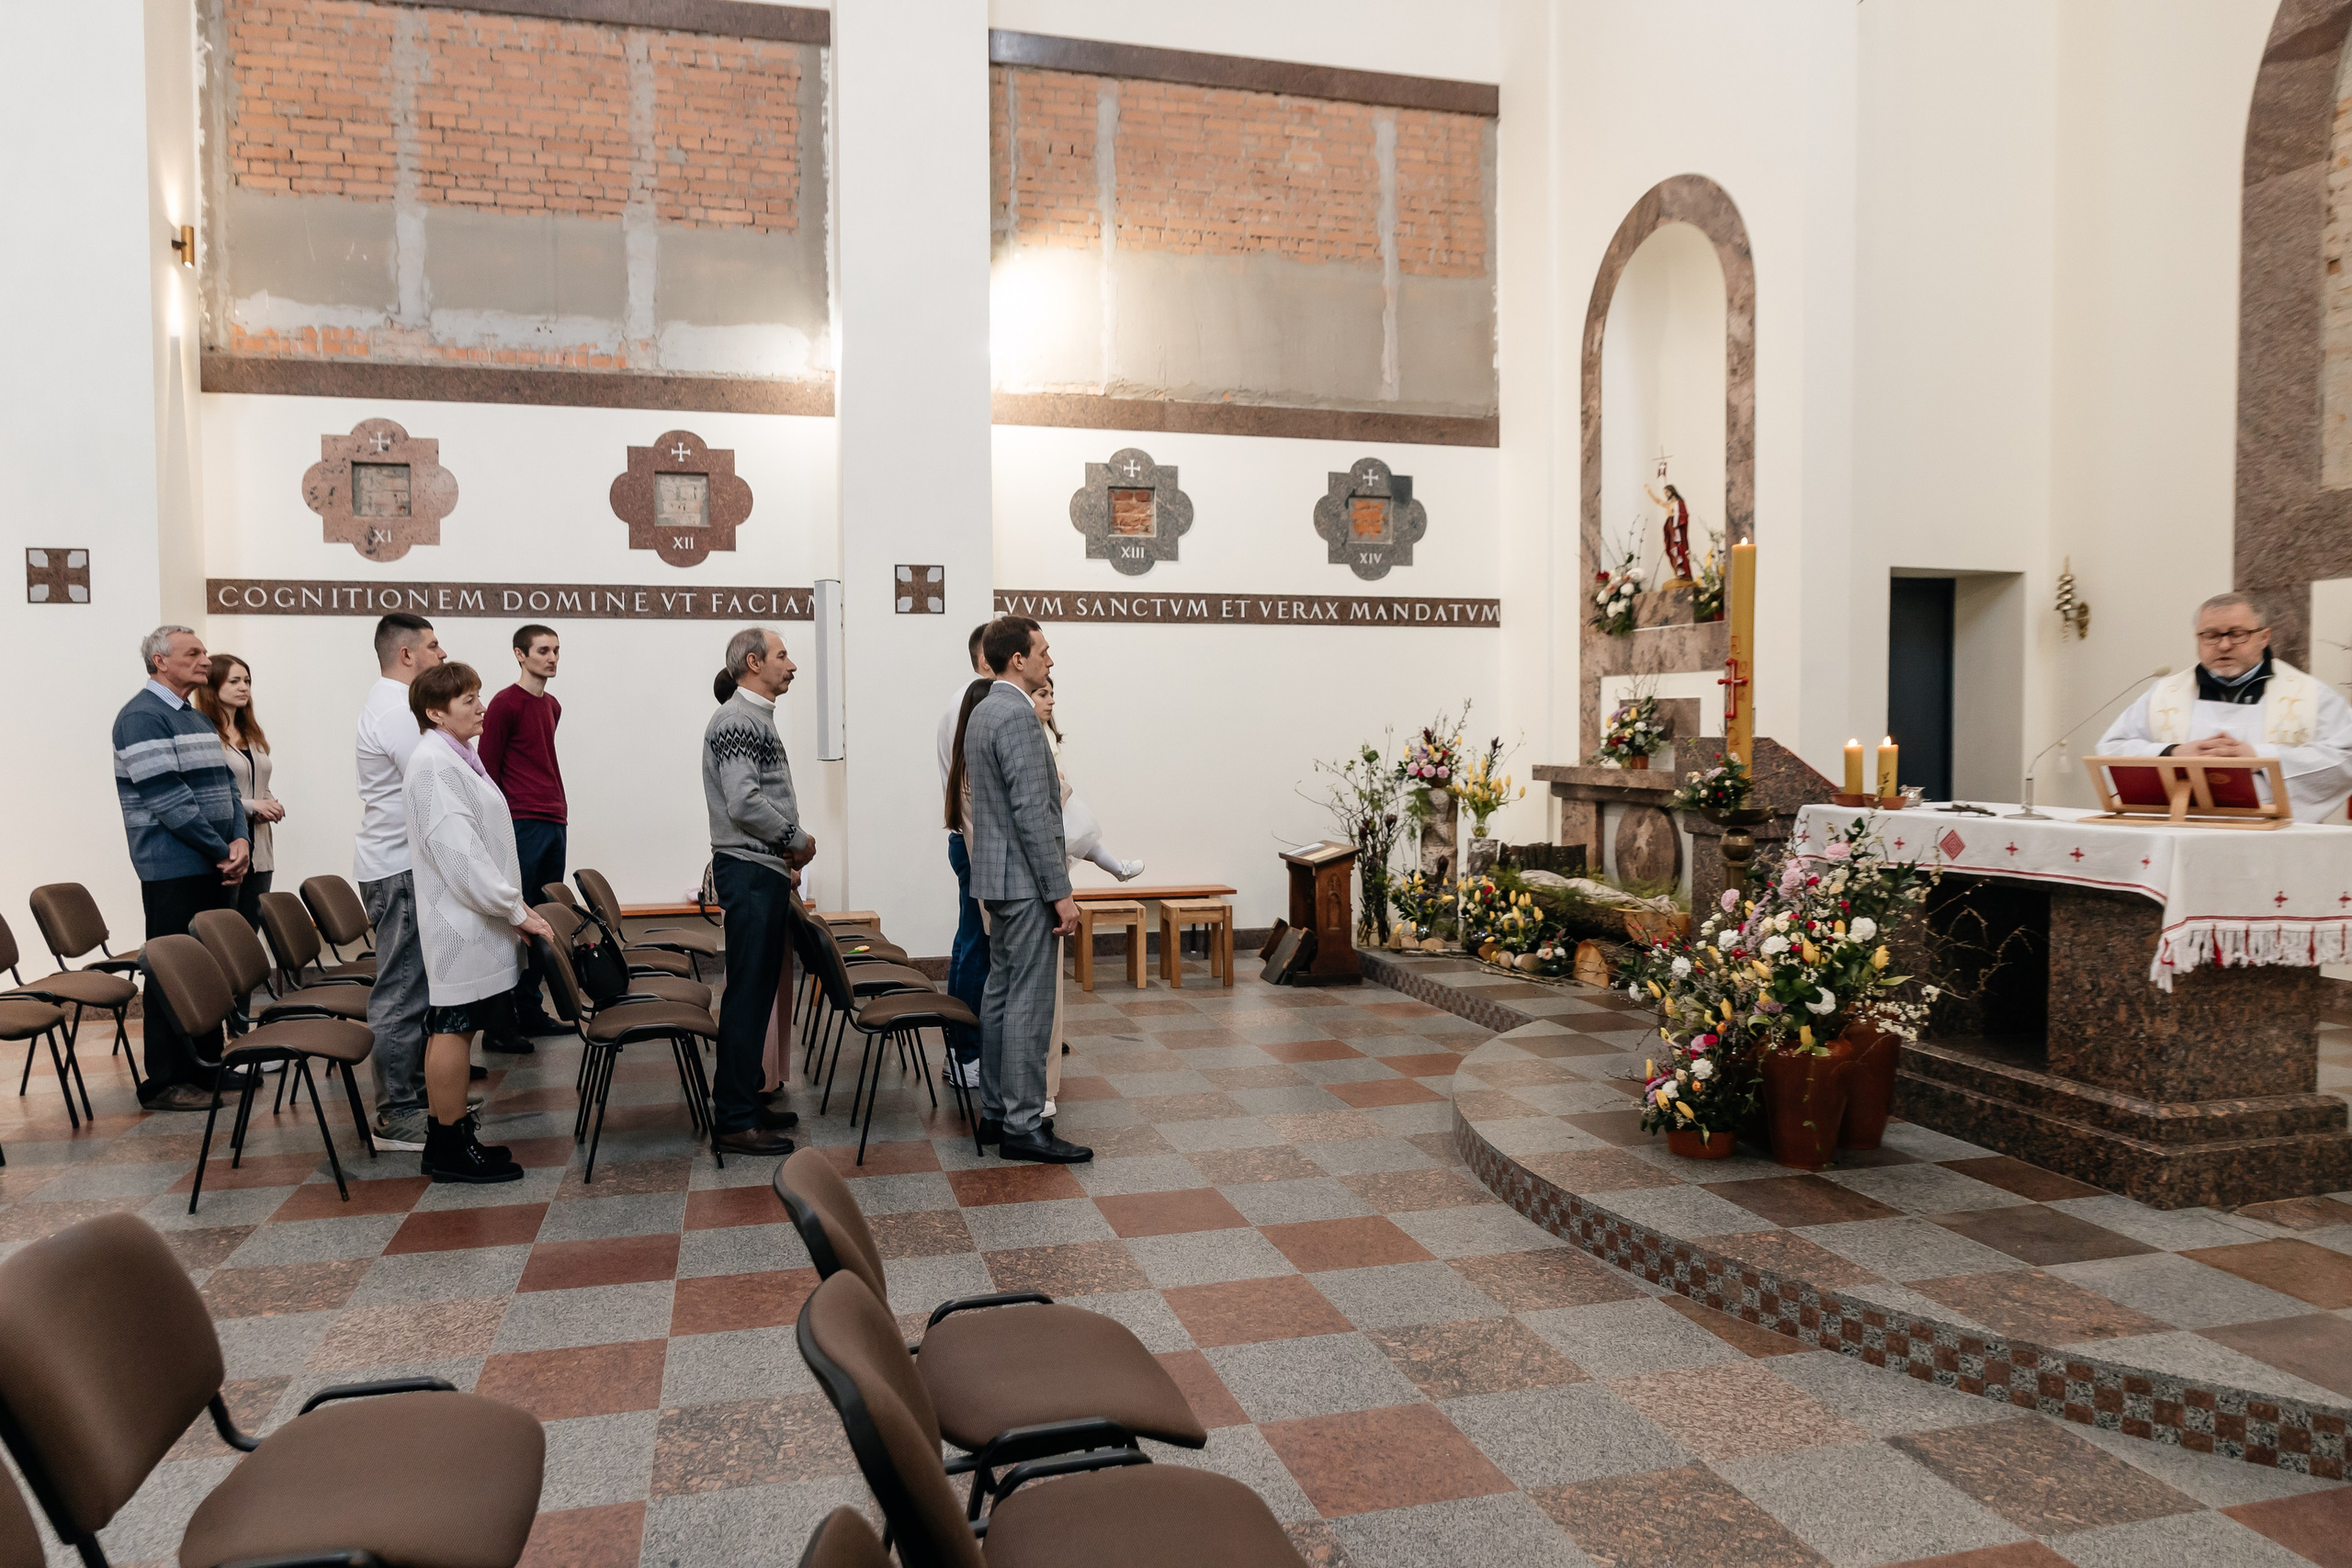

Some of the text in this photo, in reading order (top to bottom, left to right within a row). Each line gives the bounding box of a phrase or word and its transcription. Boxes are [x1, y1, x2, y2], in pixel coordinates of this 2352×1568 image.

[374, 529, 391, 543] XI
[673, 536, 694, 549] XII
[1121, 546, 1145, 558] XIII
[1359, 552, 1383, 564] XIV
[218, 585, 486, 610] COGNITIONEM
[502, 590, 650, 613] DOMINE
[660, 592, 698, 613] VT
[1075, 597, 1209, 618] SANCTVM
[1222, 600, 1252, 619] ET
[1258, 601, 1340, 620] VERAX
[1349, 603, 1501, 623] MANDATVM
